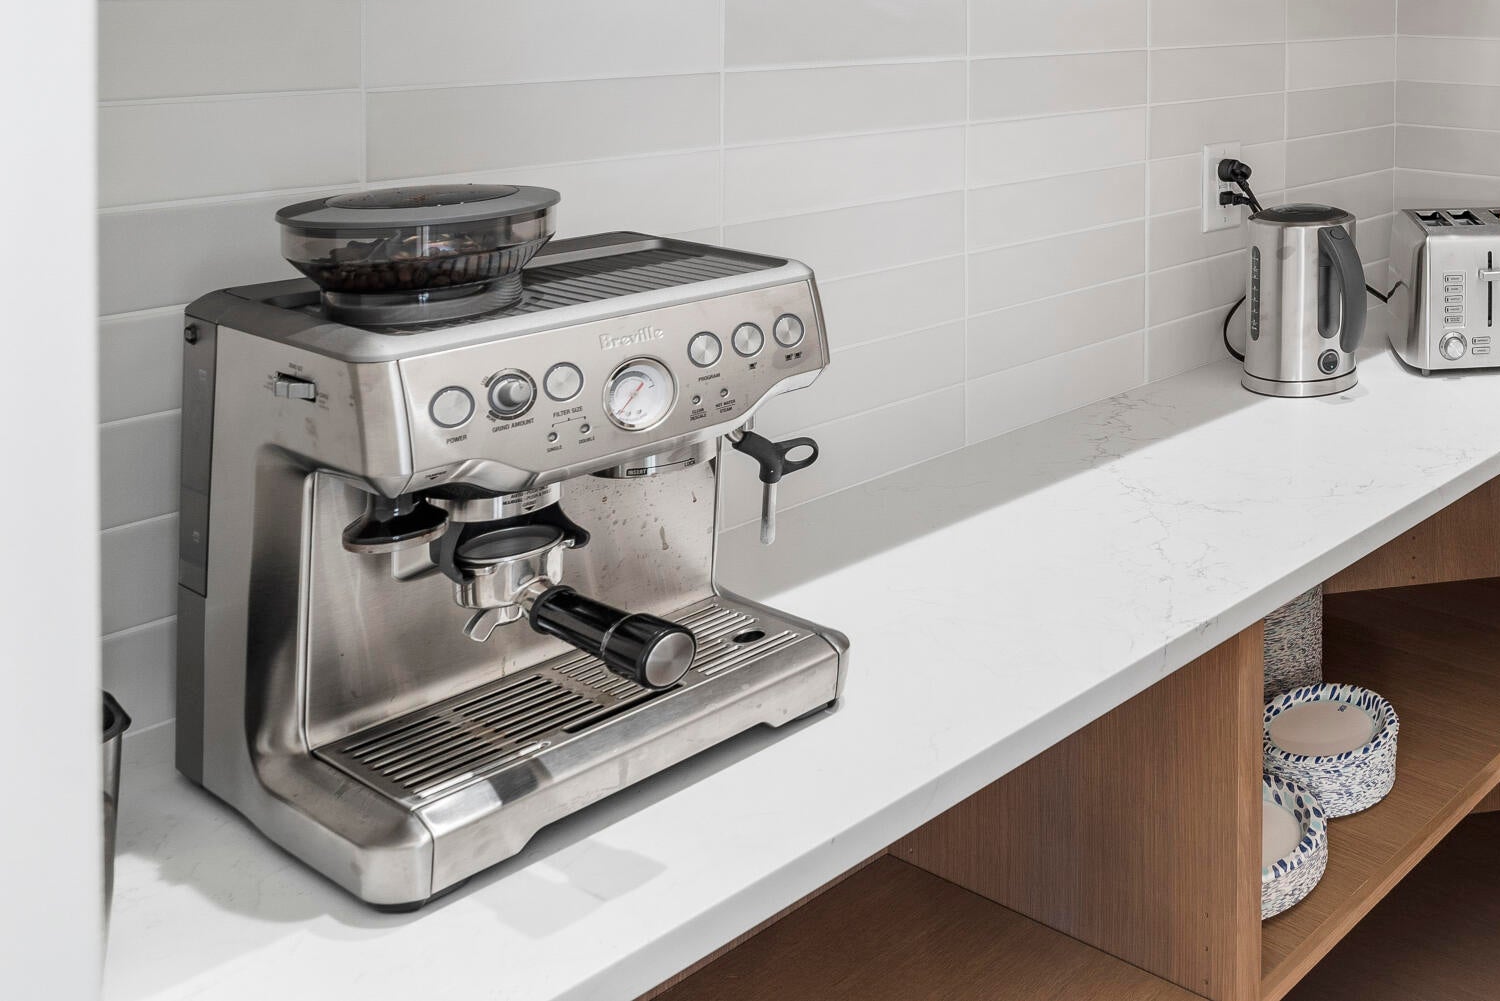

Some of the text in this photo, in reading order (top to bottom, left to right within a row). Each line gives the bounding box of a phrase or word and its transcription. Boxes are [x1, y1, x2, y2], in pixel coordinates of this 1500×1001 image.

[599, 326, 664, 350] Breville
[698, 373, 720, 382] PROGRAM
[552, 405, 583, 418] FILTER SIZE
[492, 417, 535, 433] GRIND AMOUNT
[446, 434, 468, 444] POWER
